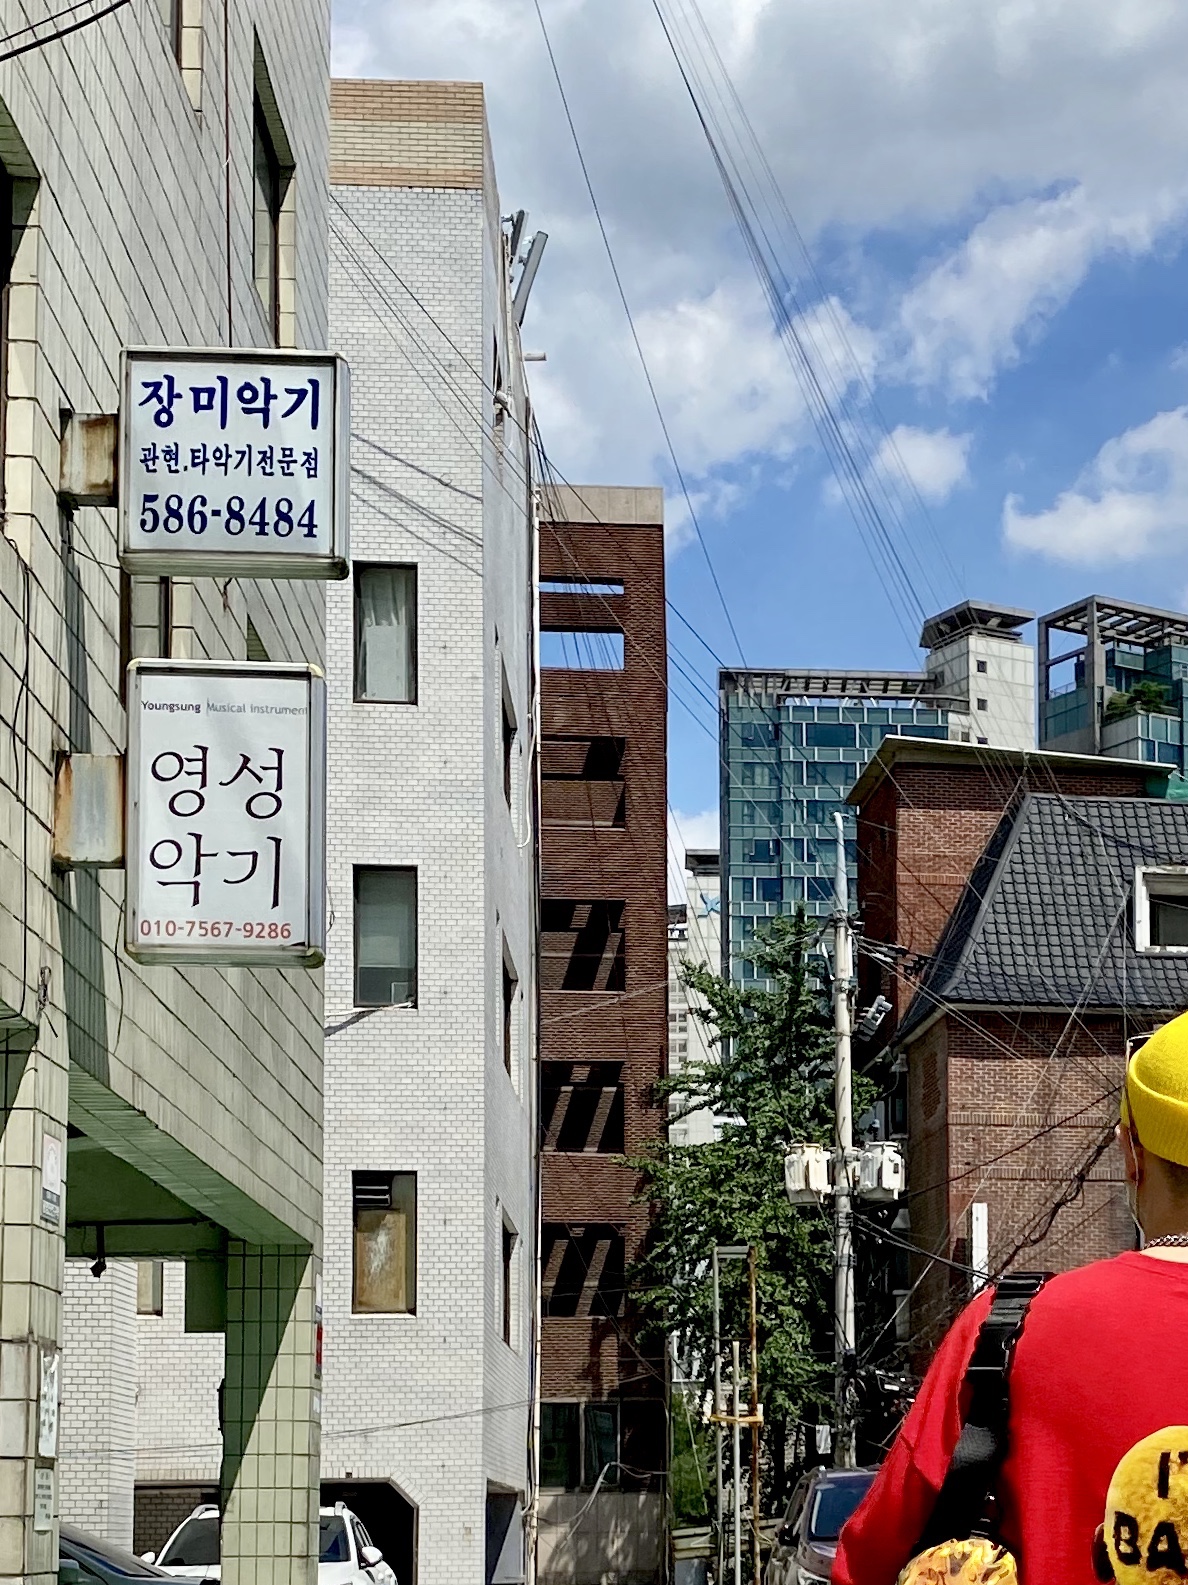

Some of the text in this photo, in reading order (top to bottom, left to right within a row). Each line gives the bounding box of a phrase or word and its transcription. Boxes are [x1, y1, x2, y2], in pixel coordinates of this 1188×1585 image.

[139, 374, 319, 430] 장미악기
[139, 493, 318, 538] 586-8484
[141, 700, 201, 713] Youngsung
[207, 700, 246, 714] Musical
[151, 744, 285, 819] 영성
[149, 832, 283, 909] 악기
[140, 919, 292, 940] 010-7567-9286
